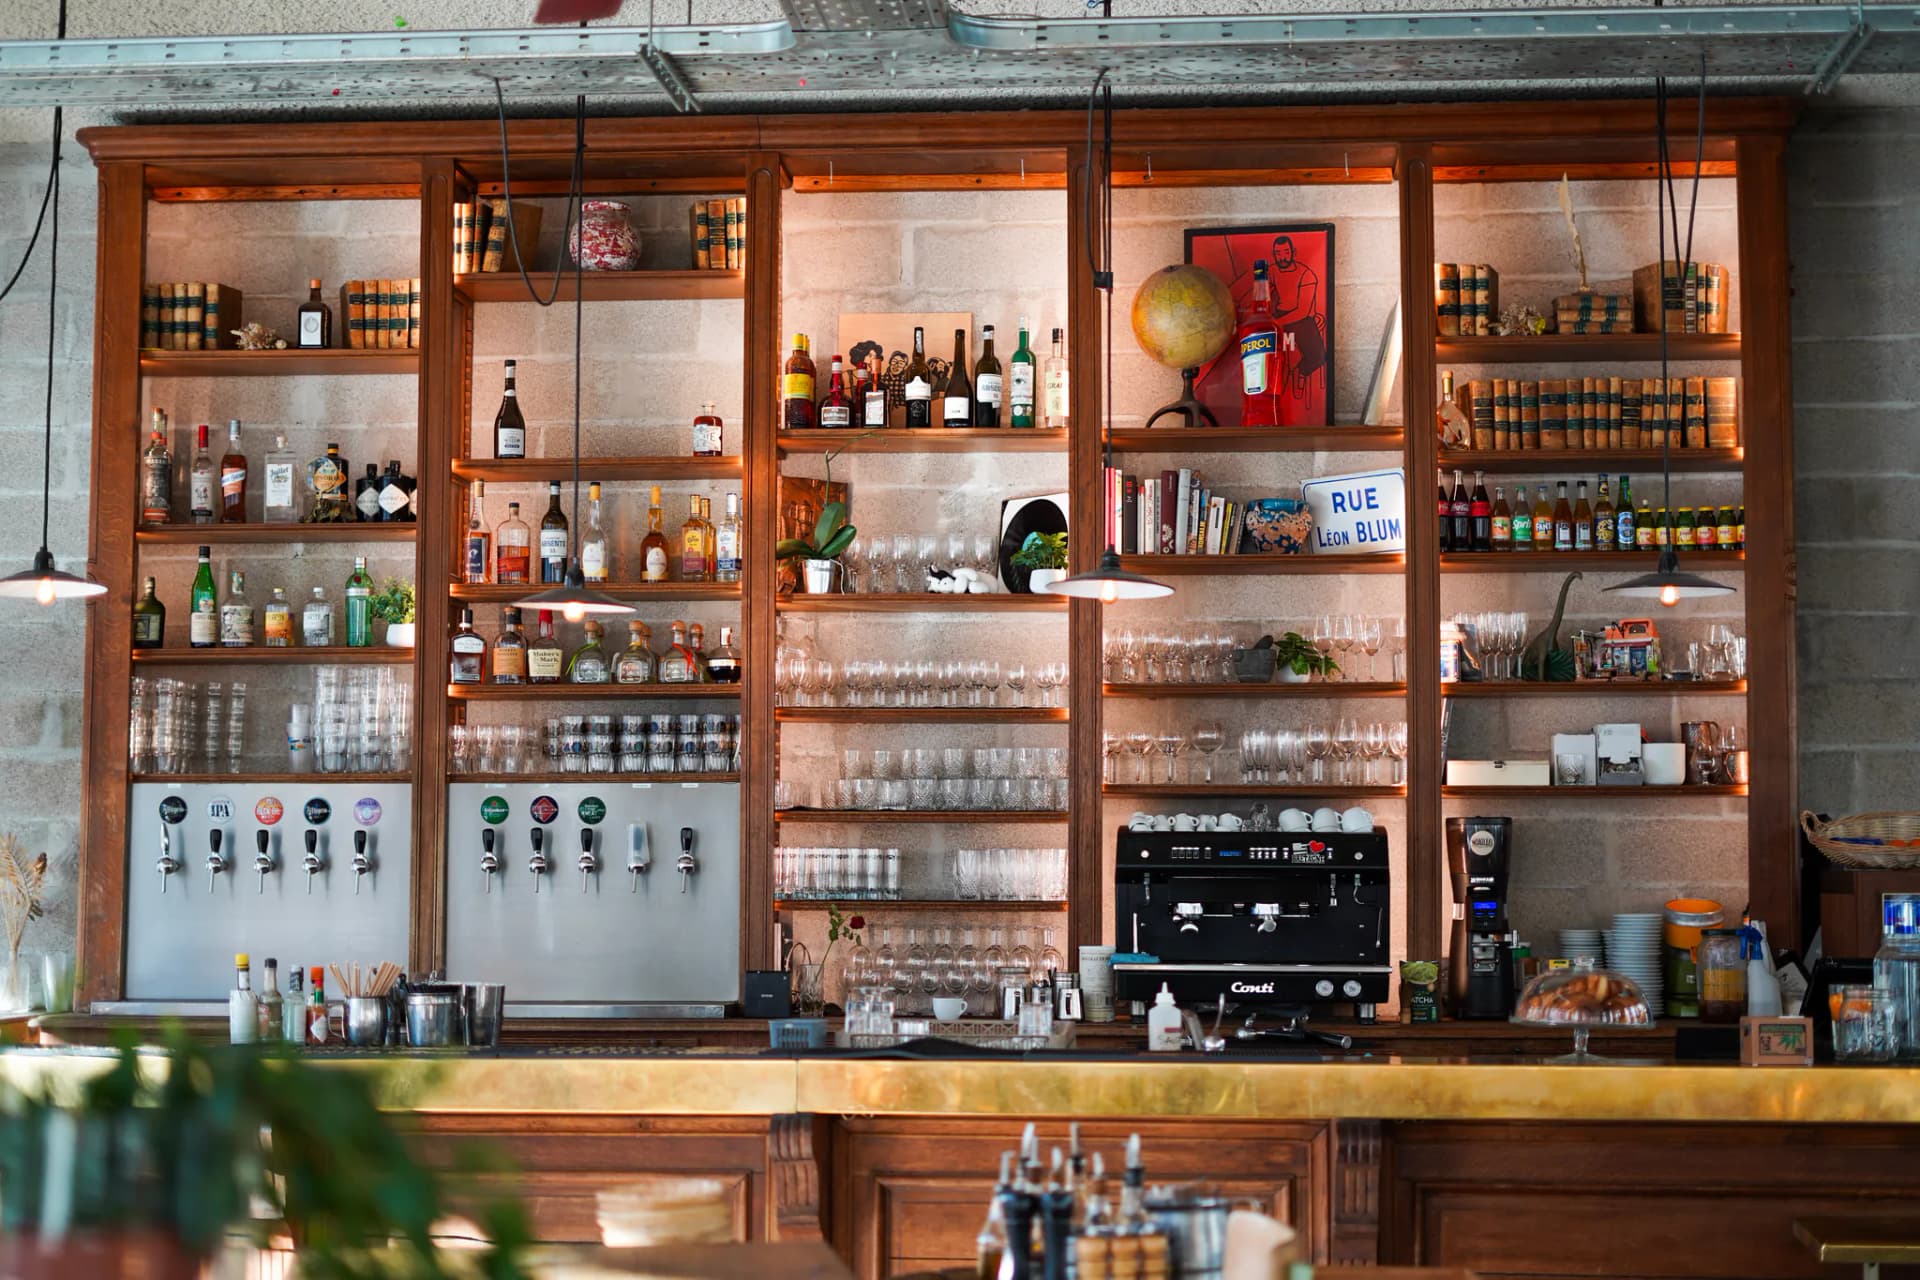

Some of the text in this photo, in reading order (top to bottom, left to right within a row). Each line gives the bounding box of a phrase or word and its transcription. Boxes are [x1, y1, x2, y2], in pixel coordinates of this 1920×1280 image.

[1331, 487, 1380, 514] RUE
[1317, 517, 1402, 548] LÉON BLUM
[1230, 981, 1275, 994] Conti
[1411, 995, 1434, 1004] ATCHA
